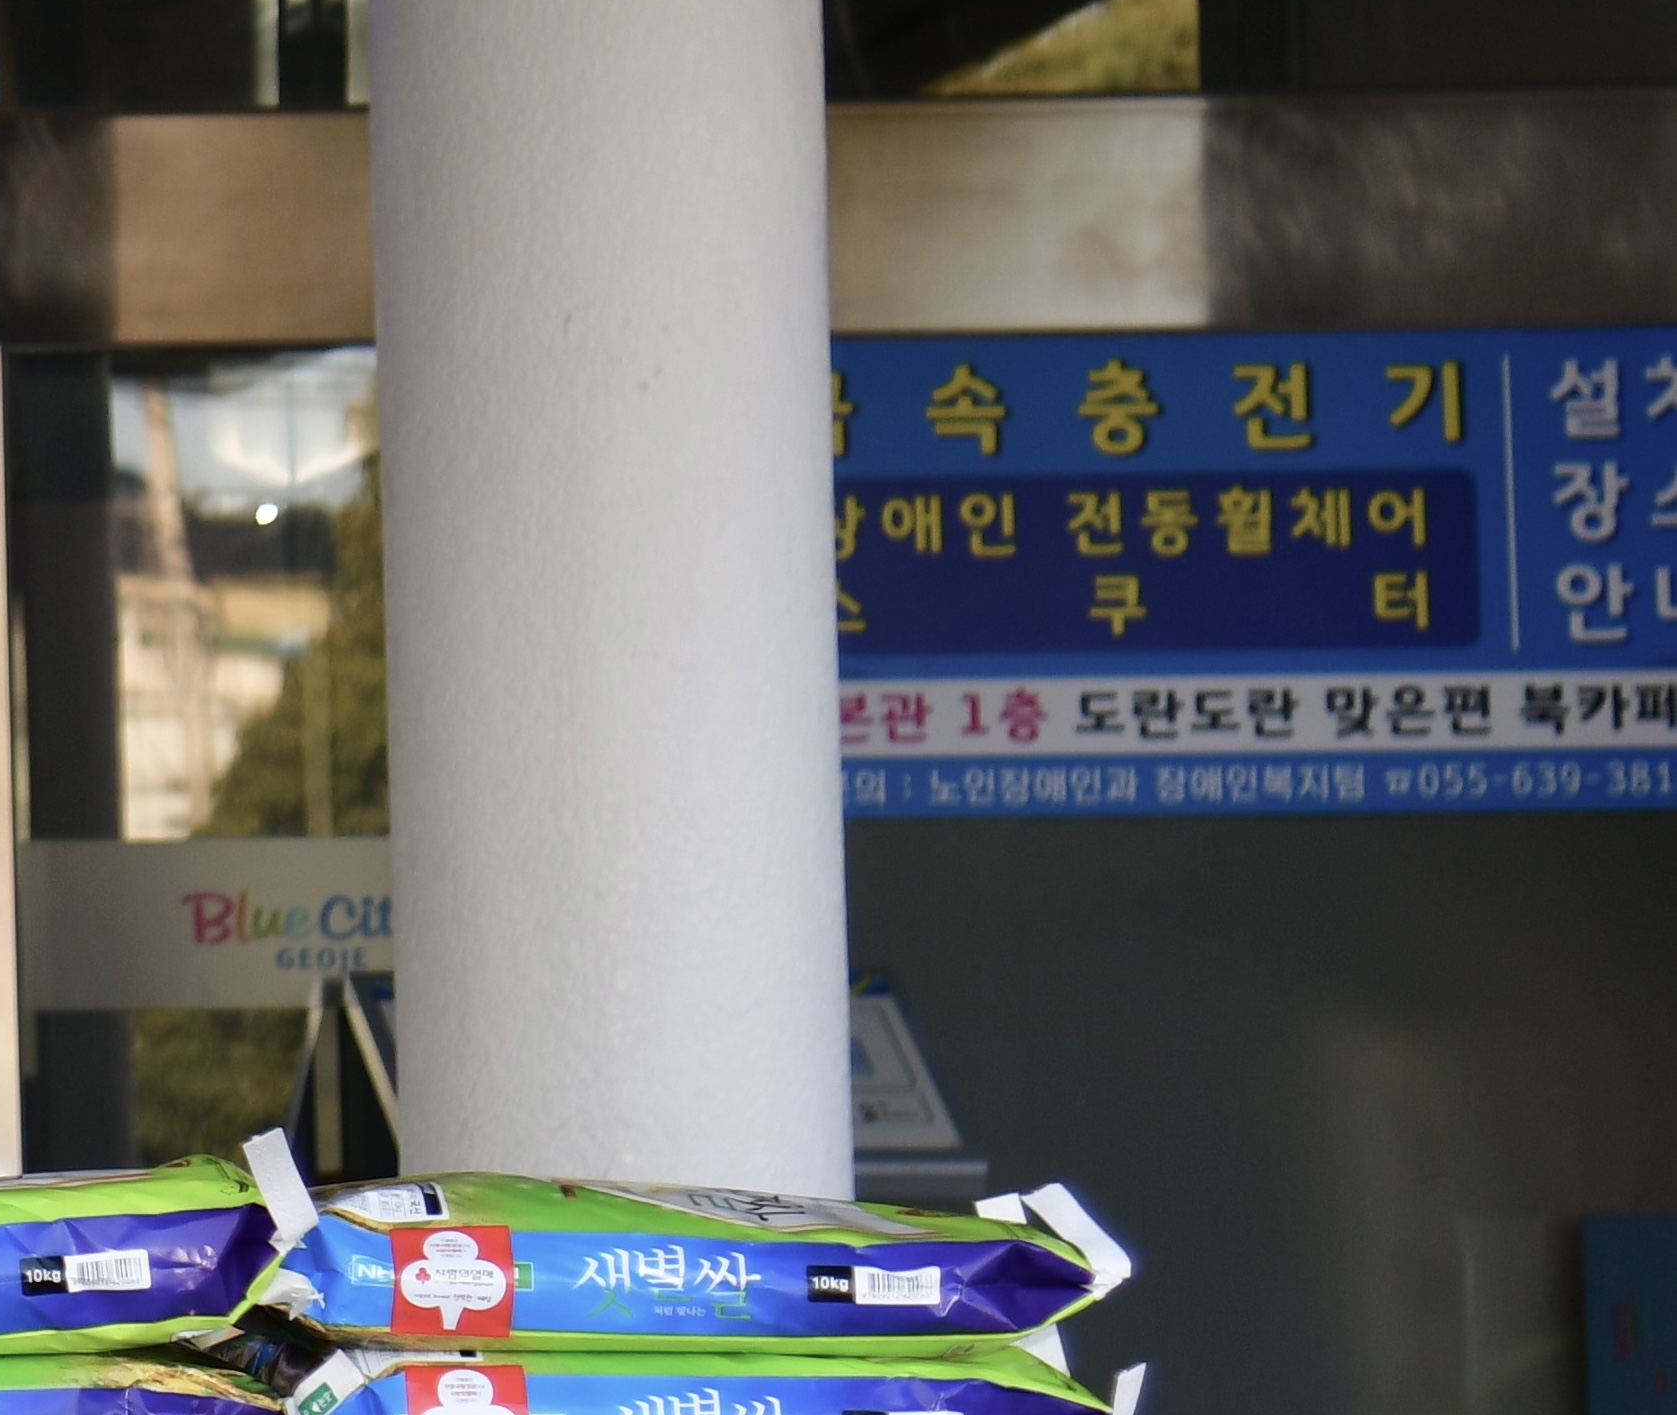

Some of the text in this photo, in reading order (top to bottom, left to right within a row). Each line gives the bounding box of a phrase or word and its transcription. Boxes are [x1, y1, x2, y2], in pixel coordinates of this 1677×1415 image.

[1069, 486, 1427, 557] 전동휠체어
[962, 688, 1048, 744] 1층
[1076, 687, 1299, 739] 도란도란
[25, 1266, 62, 1285] 10kg
[811, 1275, 849, 1293] 10kg
